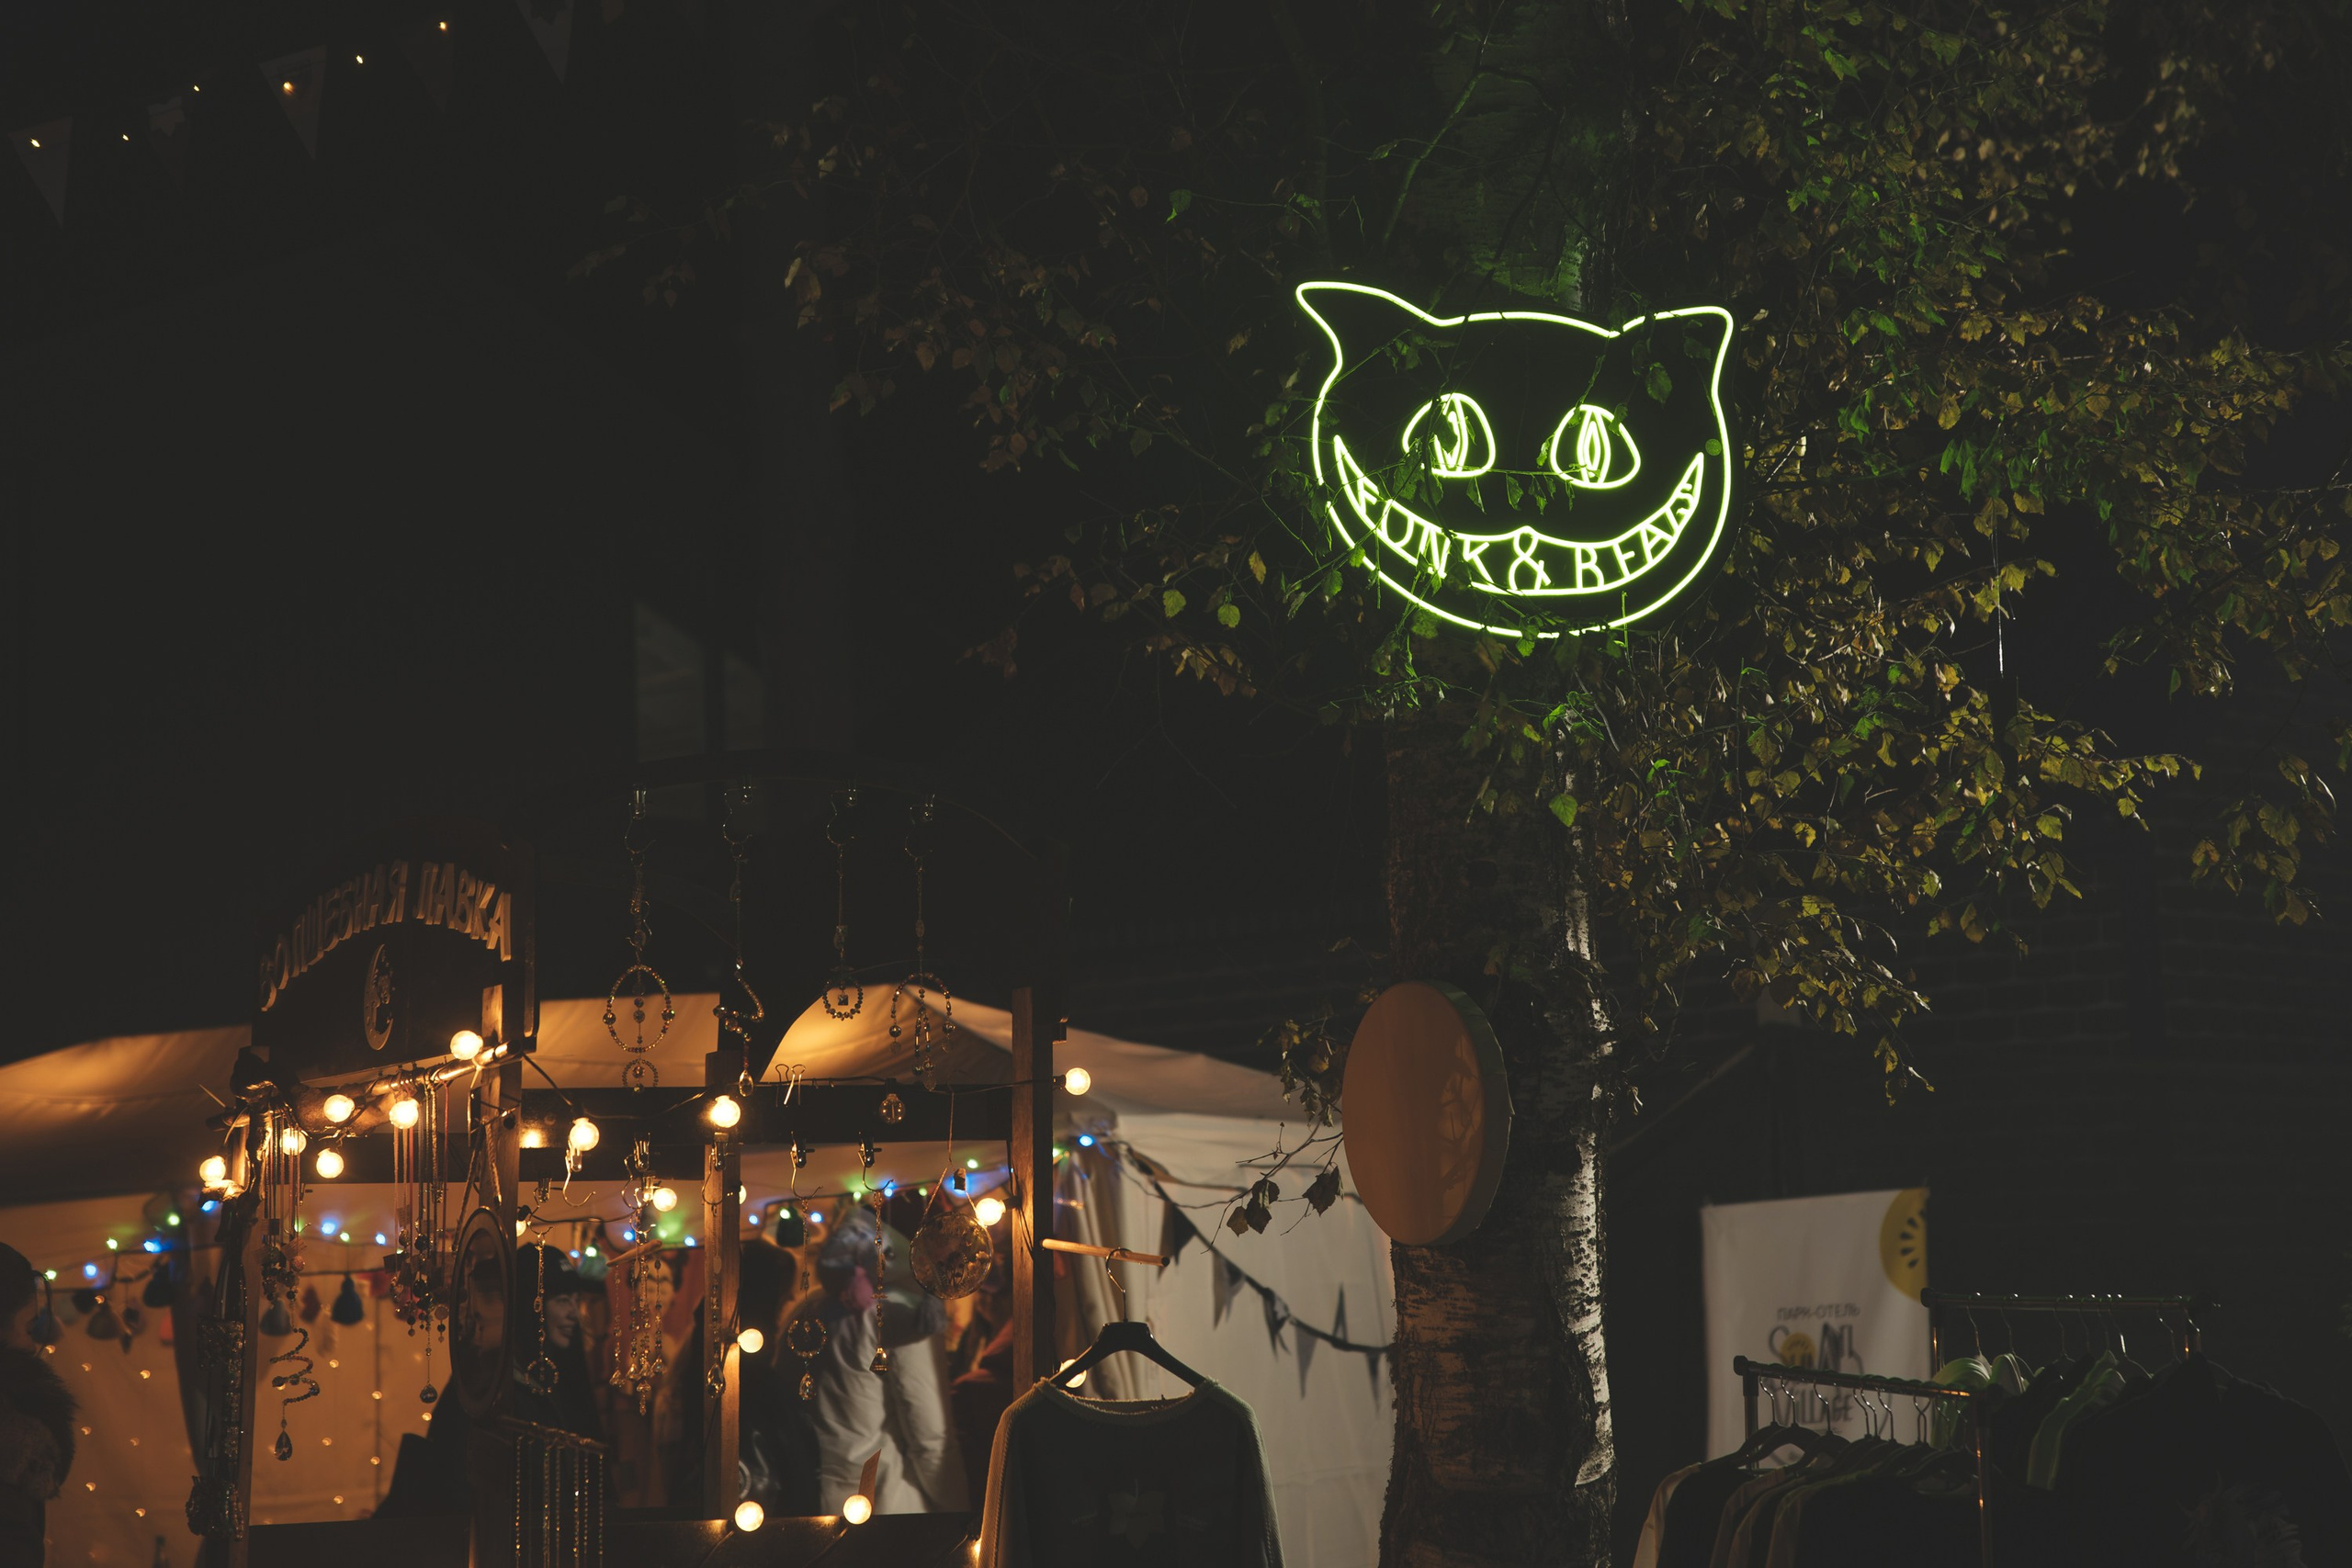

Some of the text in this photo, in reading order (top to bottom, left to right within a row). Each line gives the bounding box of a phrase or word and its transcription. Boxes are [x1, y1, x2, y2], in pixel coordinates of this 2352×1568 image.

[1509, 525, 1551, 592] &
[258, 858, 512, 1012] ВОЛШЕБНАЯ ЛАВКА
[1777, 1303, 1860, 1321] ПАРК-ОТЕЛЬ
